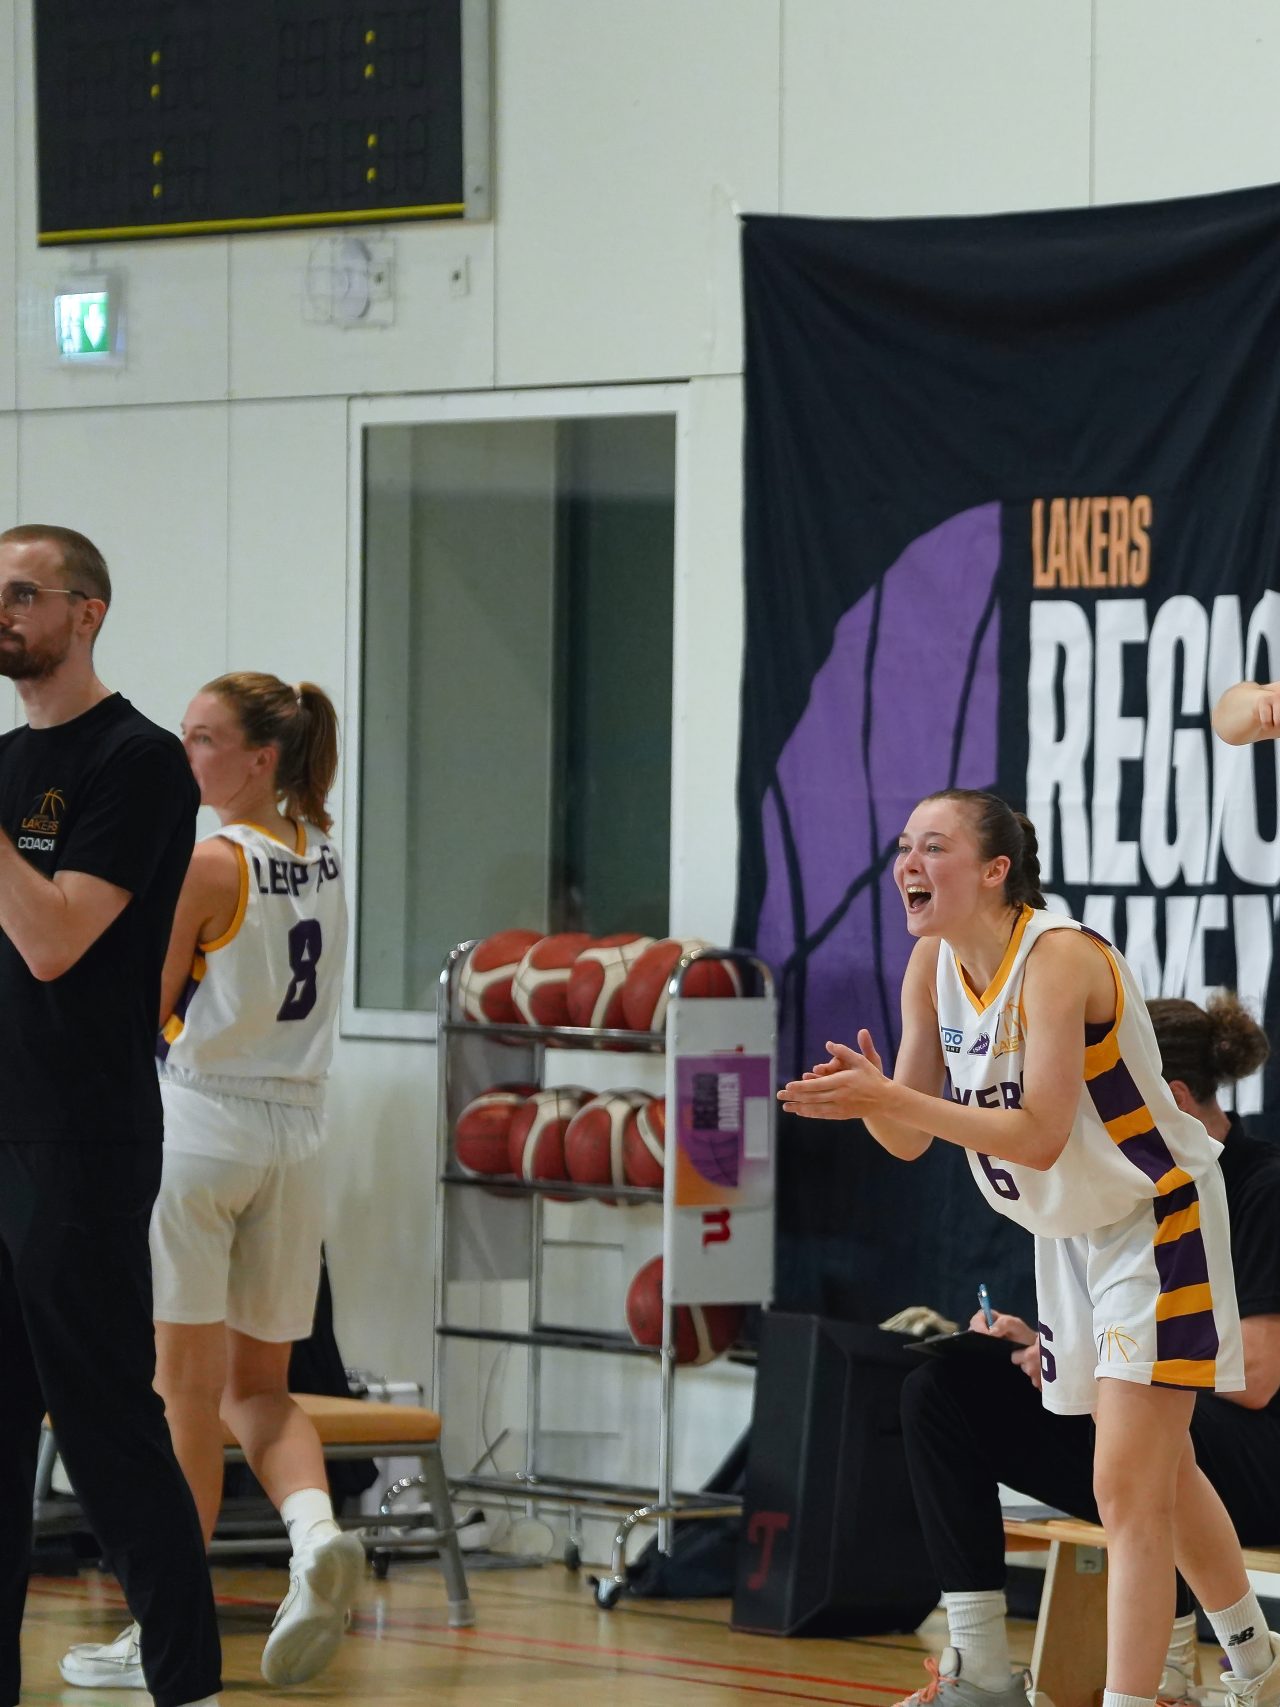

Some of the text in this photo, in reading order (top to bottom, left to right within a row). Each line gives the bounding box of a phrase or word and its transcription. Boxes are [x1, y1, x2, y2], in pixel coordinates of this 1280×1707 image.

[1031, 495, 1153, 589] LAKERS
[17, 836, 55, 852] COACH
[21, 817, 60, 832] LAKERS
[276, 918, 323, 1022] 8
